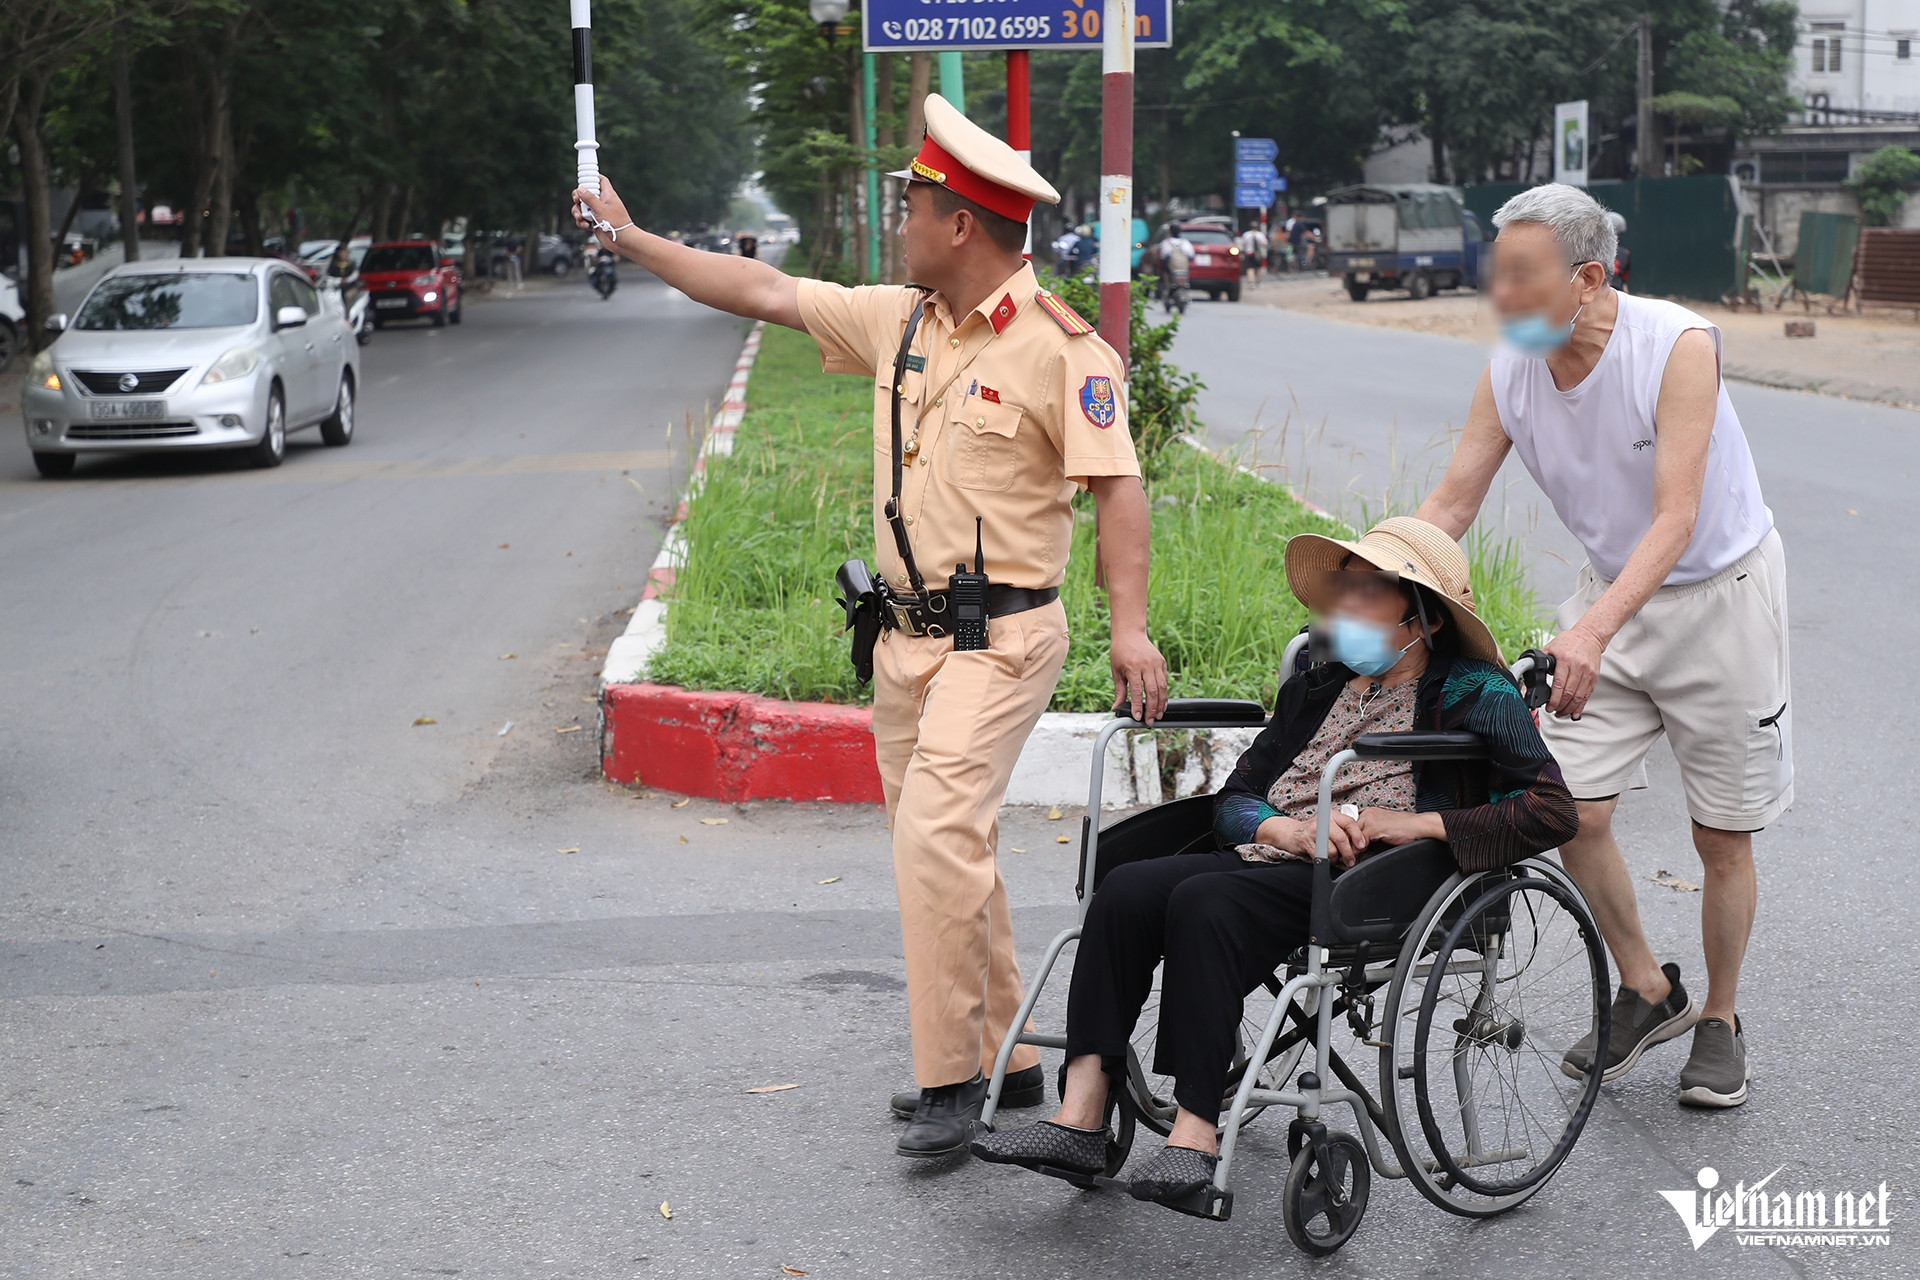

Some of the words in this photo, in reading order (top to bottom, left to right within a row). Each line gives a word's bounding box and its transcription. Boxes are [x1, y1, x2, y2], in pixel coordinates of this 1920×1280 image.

[904, 18, 944, 41] 028
[946, 17, 997, 40] 7102
[1000, 16, 1051, 39] 6595
[1089, 403, 1100, 411] CS
